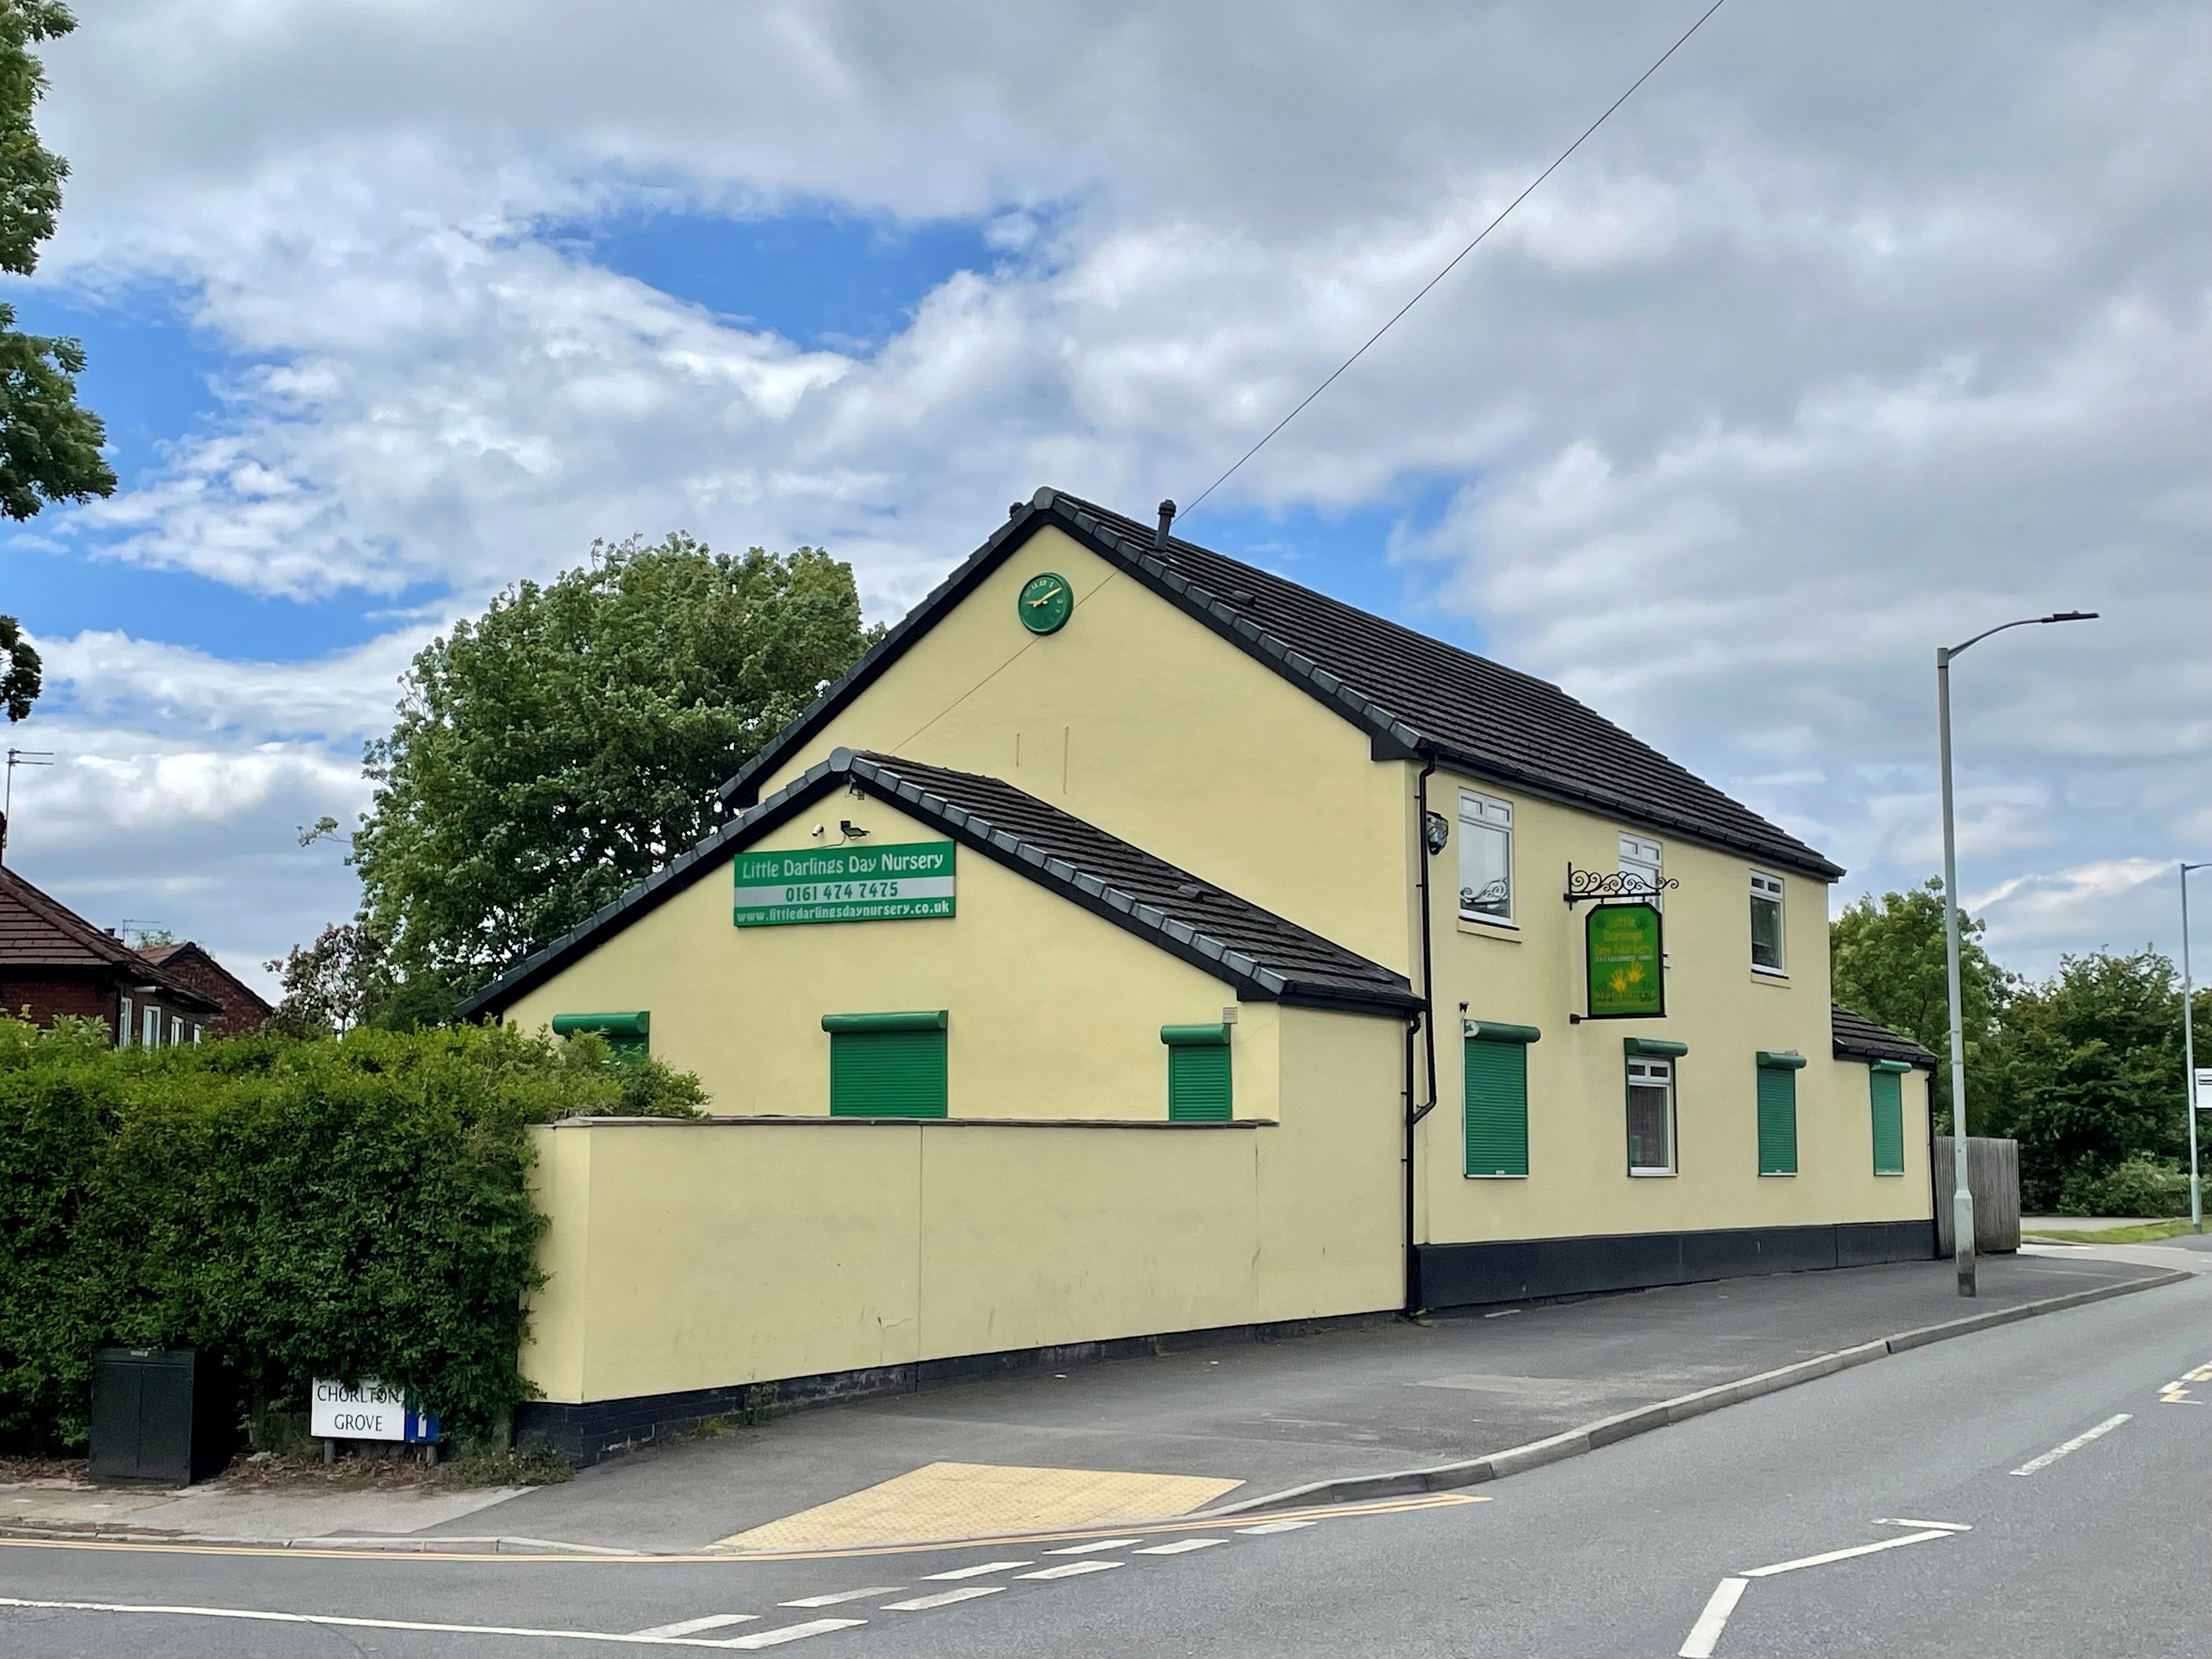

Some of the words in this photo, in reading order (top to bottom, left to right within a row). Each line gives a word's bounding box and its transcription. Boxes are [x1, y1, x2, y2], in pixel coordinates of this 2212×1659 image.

[742, 859, 780, 879] Little
[783, 857, 844, 877] Darlings
[848, 855, 877, 873] Day
[881, 853, 944, 872] Nursery
[785, 885, 817, 902] 0161
[823, 884, 853, 901] 474
[859, 881, 898, 899] 7475
[737, 900, 950, 923] www.littledarlingsdaynursery.co.uk
[334, 1414, 383, 1432] GROVE
